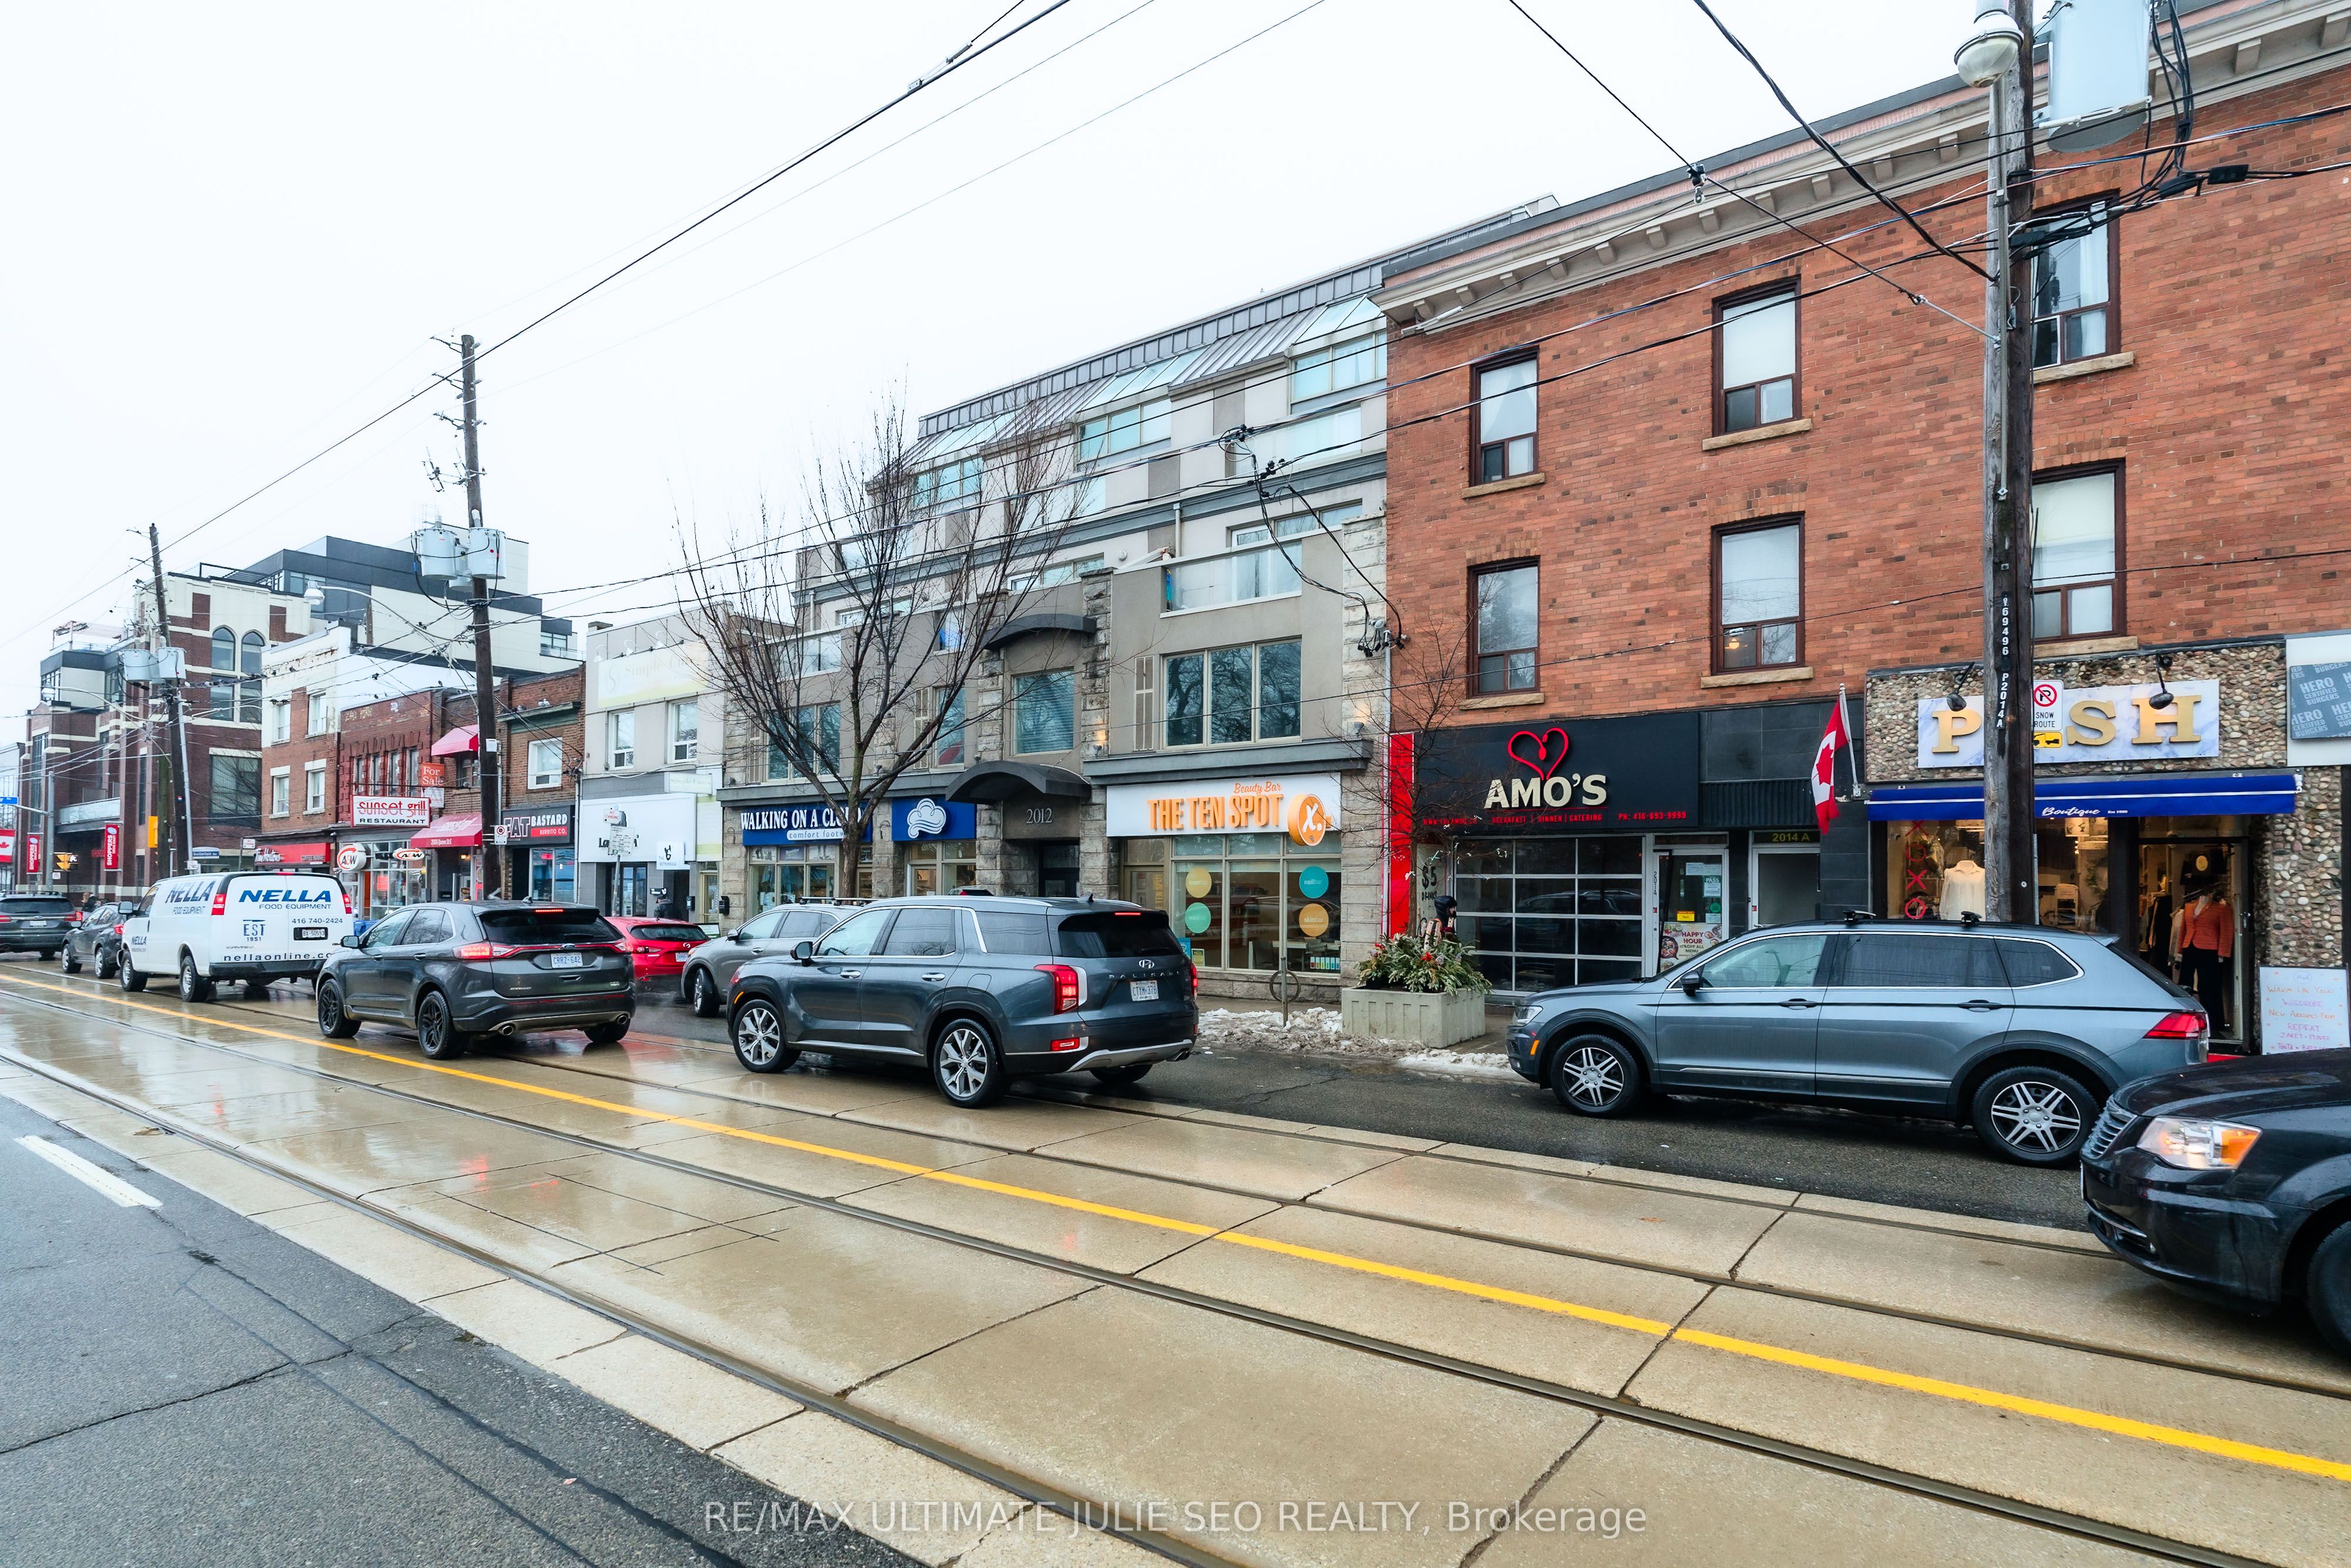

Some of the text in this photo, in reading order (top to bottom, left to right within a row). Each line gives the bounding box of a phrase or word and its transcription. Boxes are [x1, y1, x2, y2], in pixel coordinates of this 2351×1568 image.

[2299, 677, 2334, 693] HERO
[2304, 687, 2337, 699] CERTIFIED
[2306, 693, 2340, 705] BURGERS
[1996, 673, 2009, 728] P2014A
[1931, 695, 2202, 754] PSH
[2292, 719, 2326, 731] CERTIFIED
[2294, 725, 2328, 737] BURGERS
[423, 766, 440, 776] For
[422, 776, 444, 786] Sale
[1234, 781, 1282, 795] Beauty Bar
[1484, 773, 1607, 809] AMO'S
[1026, 808, 1053, 823] 2012
[1147, 793, 1284, 830] THE TEN SPOT
[2041, 806, 2101, 816] Boutique
[531, 813, 568, 827] BASTARD
[741, 810, 788, 830] WALKING
[792, 809, 808, 829] ON
[808, 809, 819, 827] A
[1538, 814, 1562, 823] DINNER
[1569, 813, 1602, 822] CATERING
[789, 830, 819, 839] comfort
[1772, 833, 1810, 842] 2014 A
[165, 881, 216, 903] NELLA
[239, 890, 331, 902] NELLA
[243, 924, 266, 936] EST
[131, 936, 147, 945] NELLA
[224, 953, 331, 961] nellaonline.co
[2287, 1023, 2321, 1033] REPEAT
